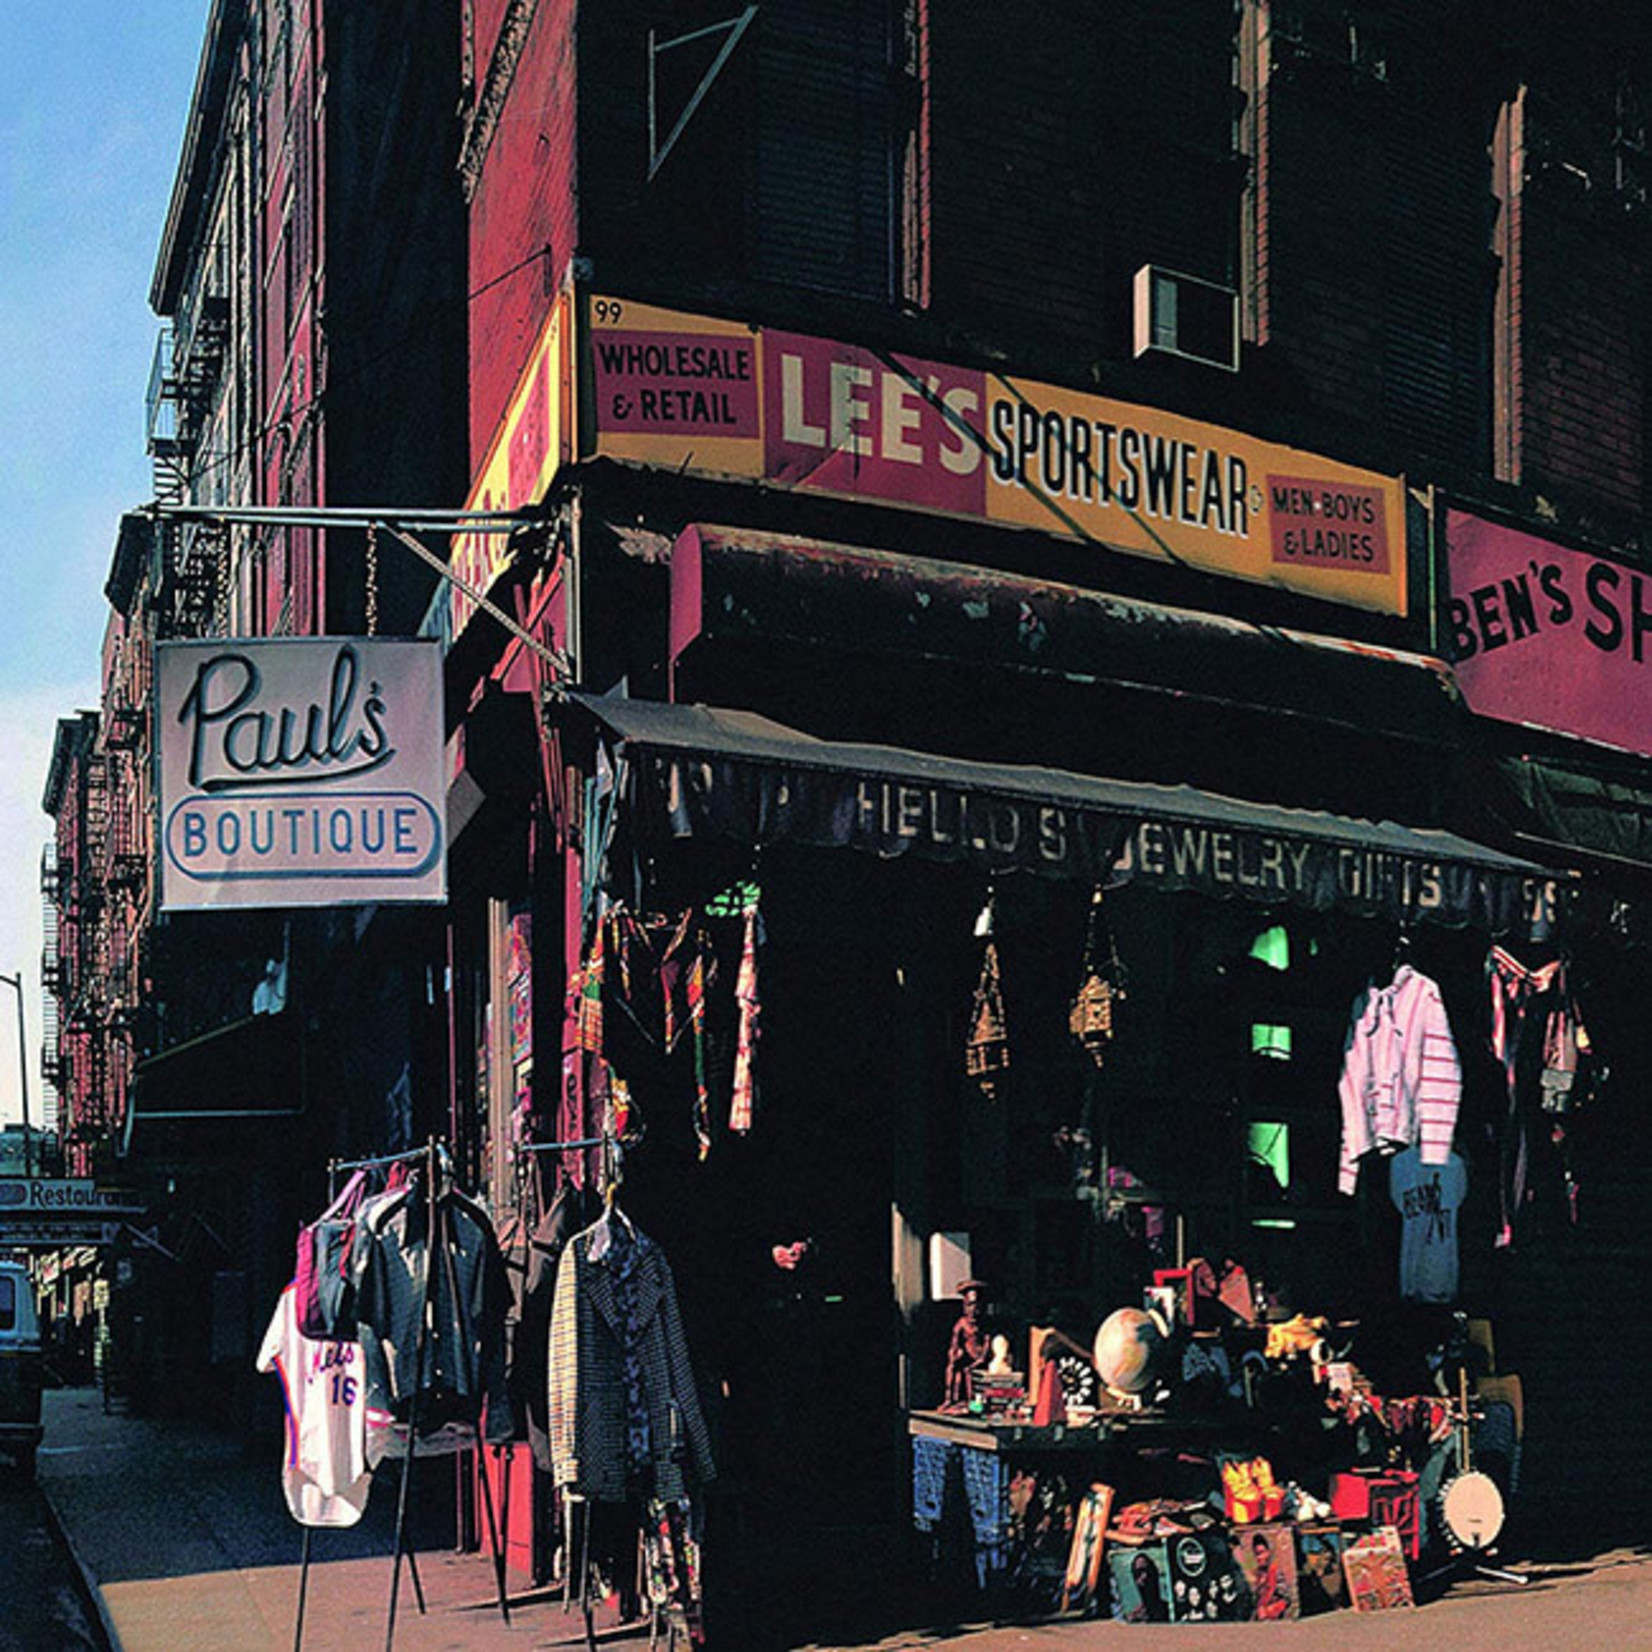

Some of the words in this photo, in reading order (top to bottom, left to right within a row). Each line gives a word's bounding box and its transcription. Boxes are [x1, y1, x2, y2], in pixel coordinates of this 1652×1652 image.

[594, 301, 622, 324] 99
[597, 342, 751, 381] WHOLESALE
[612, 394, 634, 421] &
[641, 390, 738, 425] RETAIL
[780, 353, 983, 476] LEE'S
[990, 398, 1249, 539] SPORTSWEAR
[1301, 527, 1374, 563] LADIES
[1449, 560, 1574, 664] BEN'S
[177, 643, 397, 790] Paul's
[183, 808, 418, 857] BOUTIQUE
[331, 1373, 359, 1406] 16
